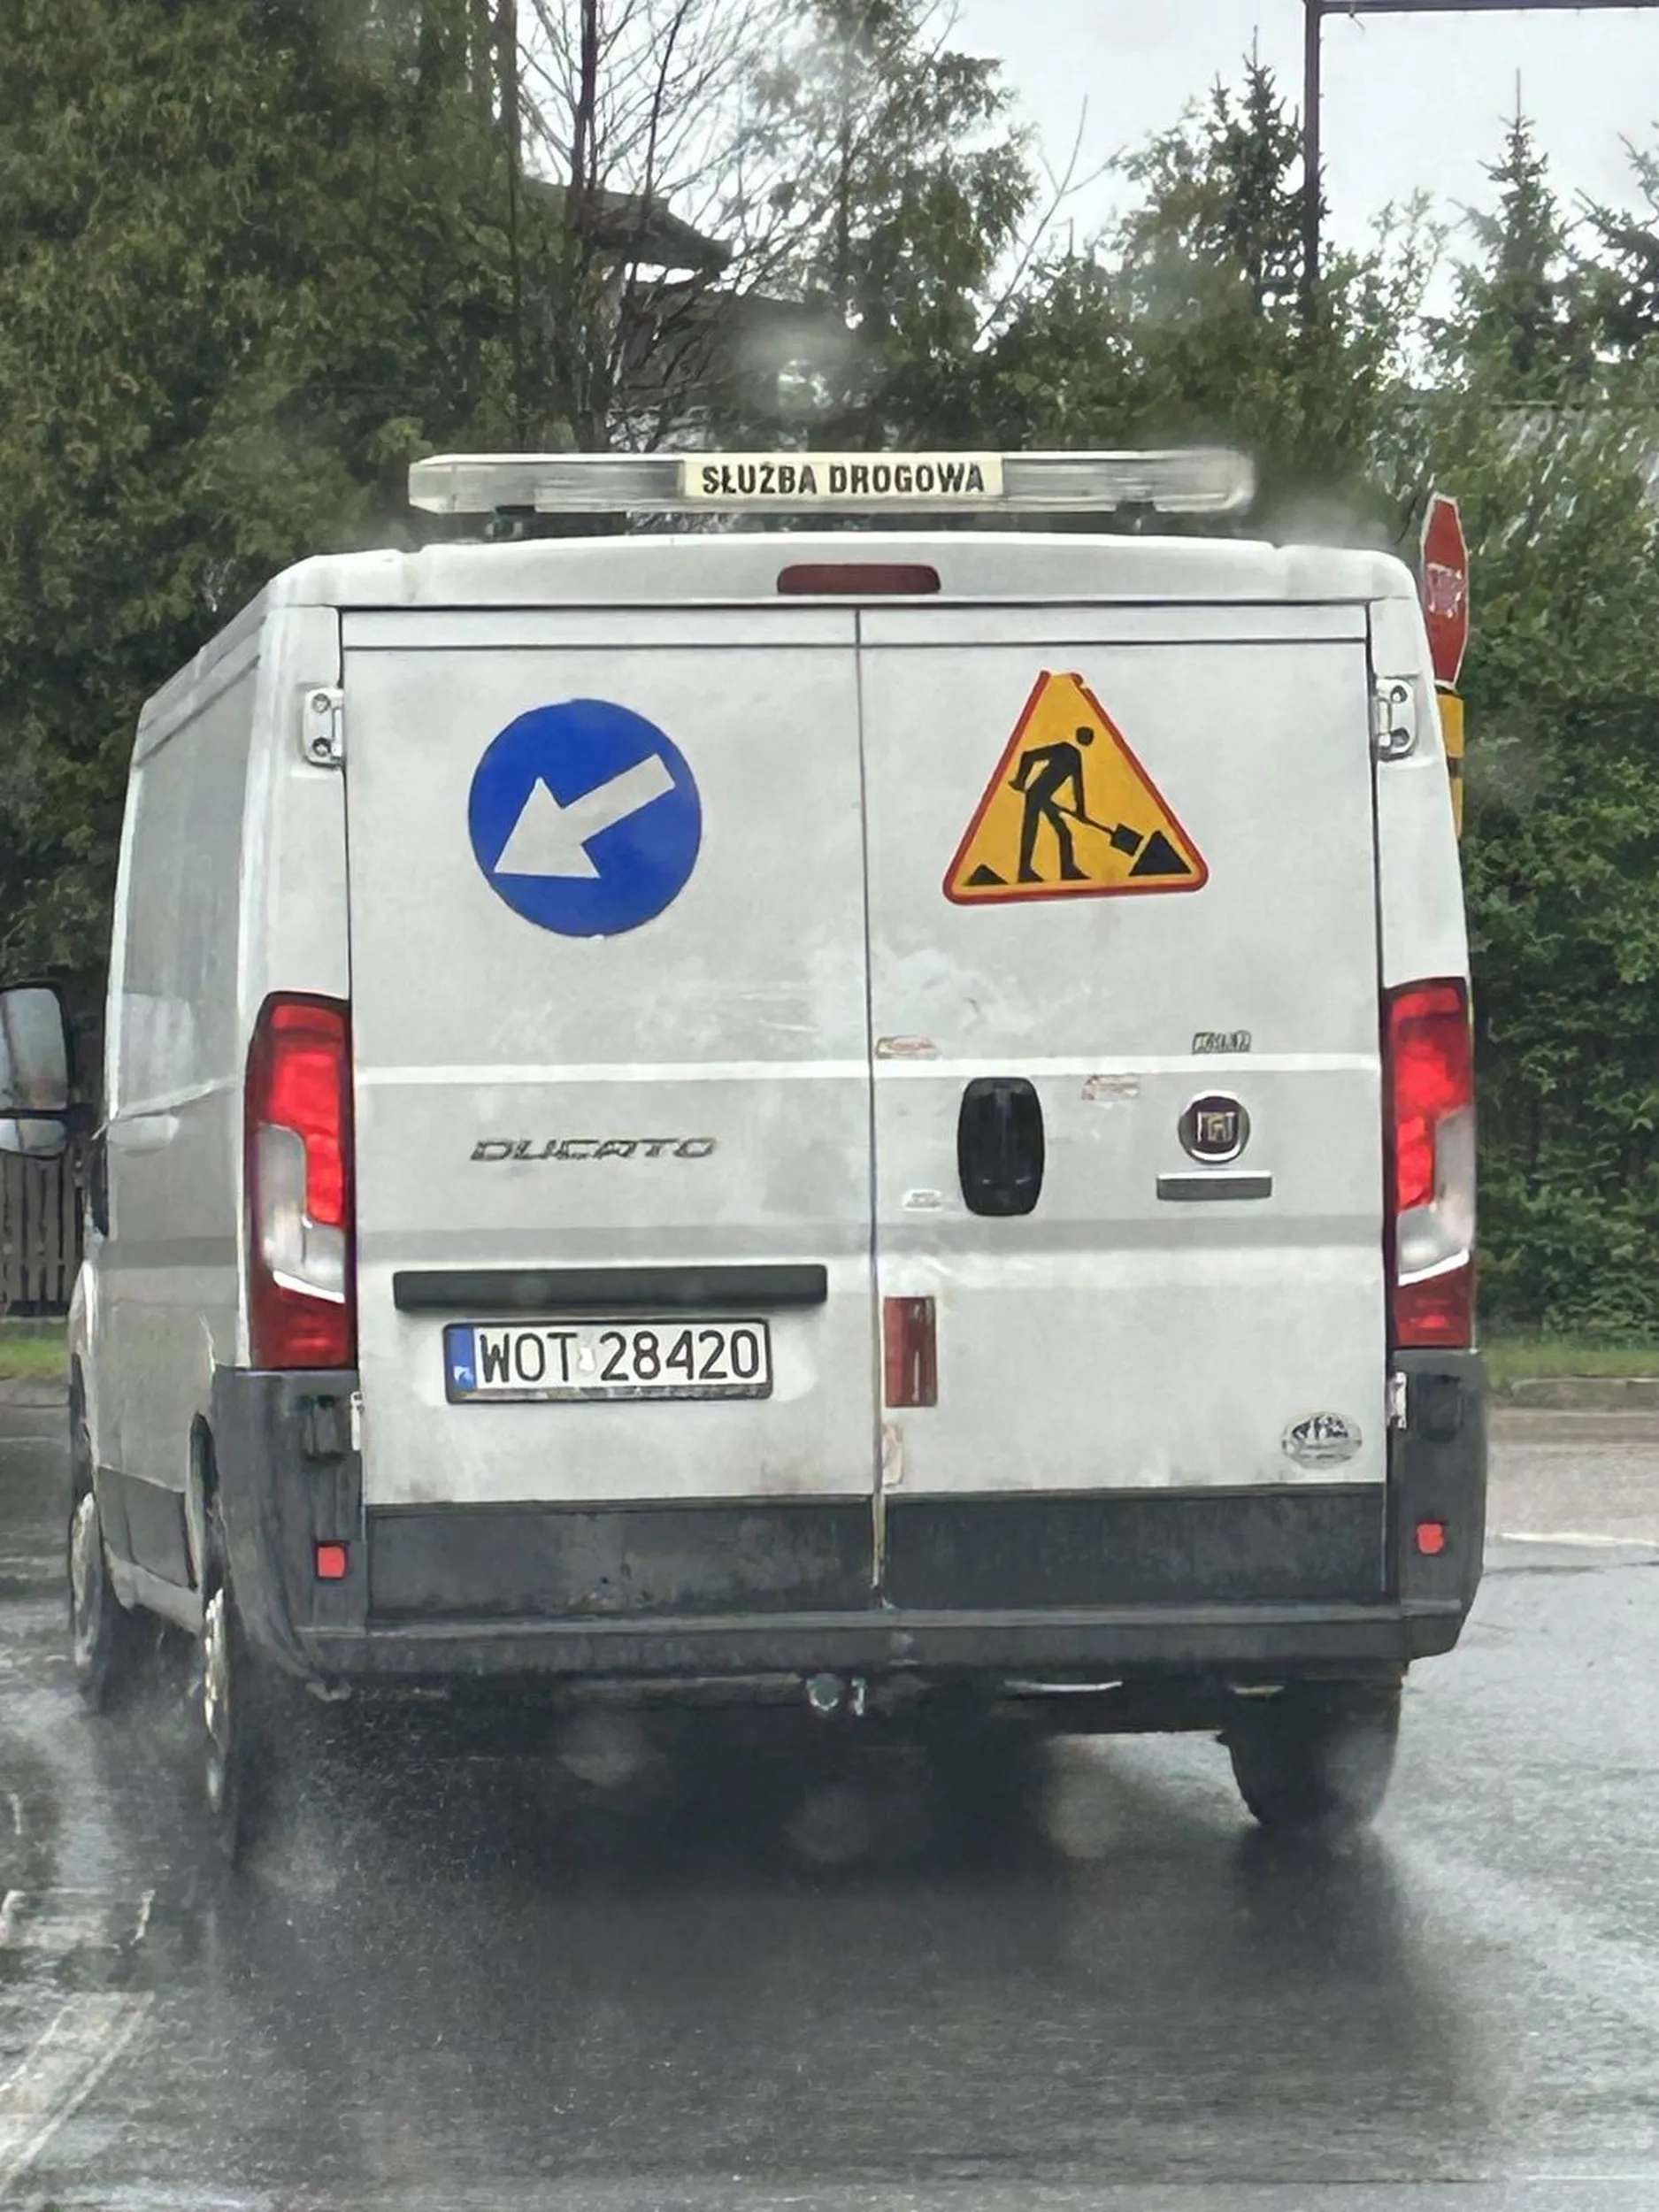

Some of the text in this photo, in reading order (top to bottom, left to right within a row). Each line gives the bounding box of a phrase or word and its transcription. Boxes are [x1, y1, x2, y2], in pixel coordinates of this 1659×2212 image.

[701, 461, 986, 495] SŁUŻBA DROGOWA
[470, 1137, 716, 1162] DUCATO
[479, 1329, 760, 1383] WOT 28420
